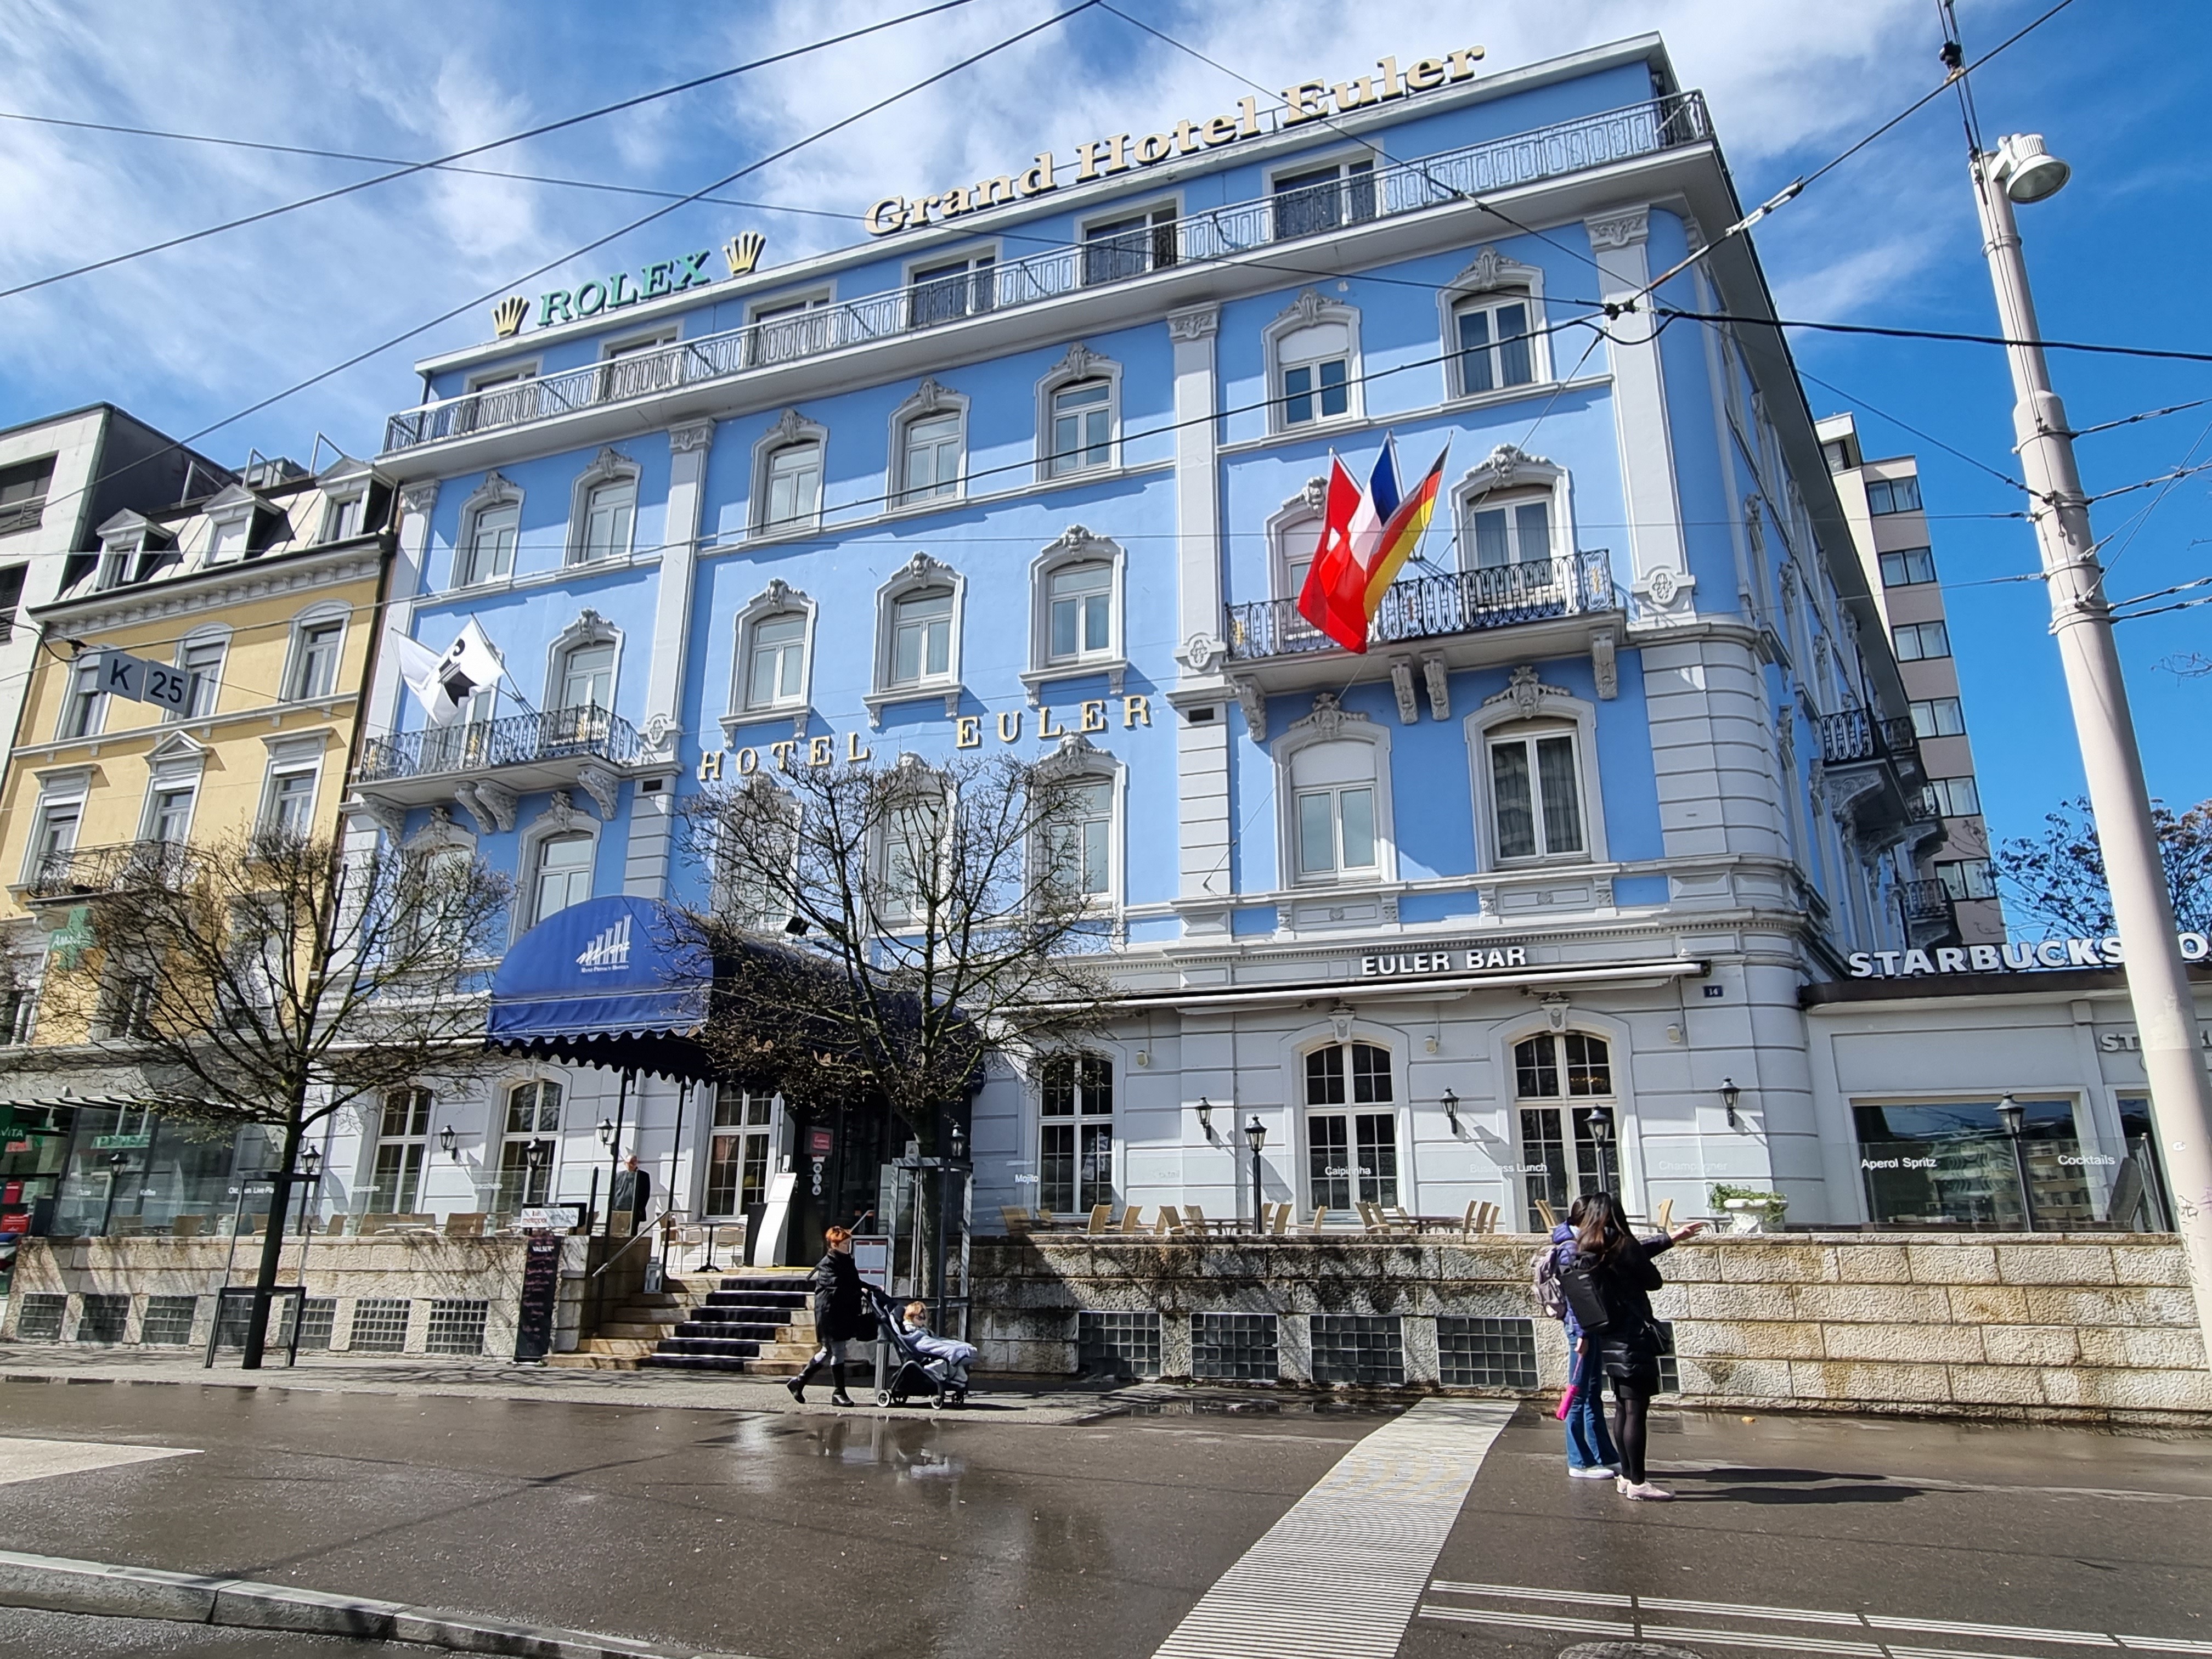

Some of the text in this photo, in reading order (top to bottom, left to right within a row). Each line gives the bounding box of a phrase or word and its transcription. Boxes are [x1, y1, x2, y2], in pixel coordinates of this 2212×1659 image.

[864, 45, 1485, 237] Grand Hotel Euler
[537, 249, 711, 326] ROLEX
[110, 658, 183, 703] K 25
[699, 695, 1150, 780] HOTEL EULER
[1362, 946, 1527, 977] EULER BAR
[1848, 936, 2125, 978] STARBUCKS
[1708, 988, 1719, 996] 14
[2101, 1032, 2139, 1052] ST
[0, 1126, 23, 1137] VITA
[1658, 1160, 1728, 1172] Champgner
[1861, 1156, 1938, 1170] Aperol Spritz
[2058, 1154, 2115, 1166] Cocktails
[1324, 1166, 1372, 1177] Caipirinha
[1517, 1163, 1548, 1173] Lunch
[1014, 1173, 1039, 1184] Mojito
